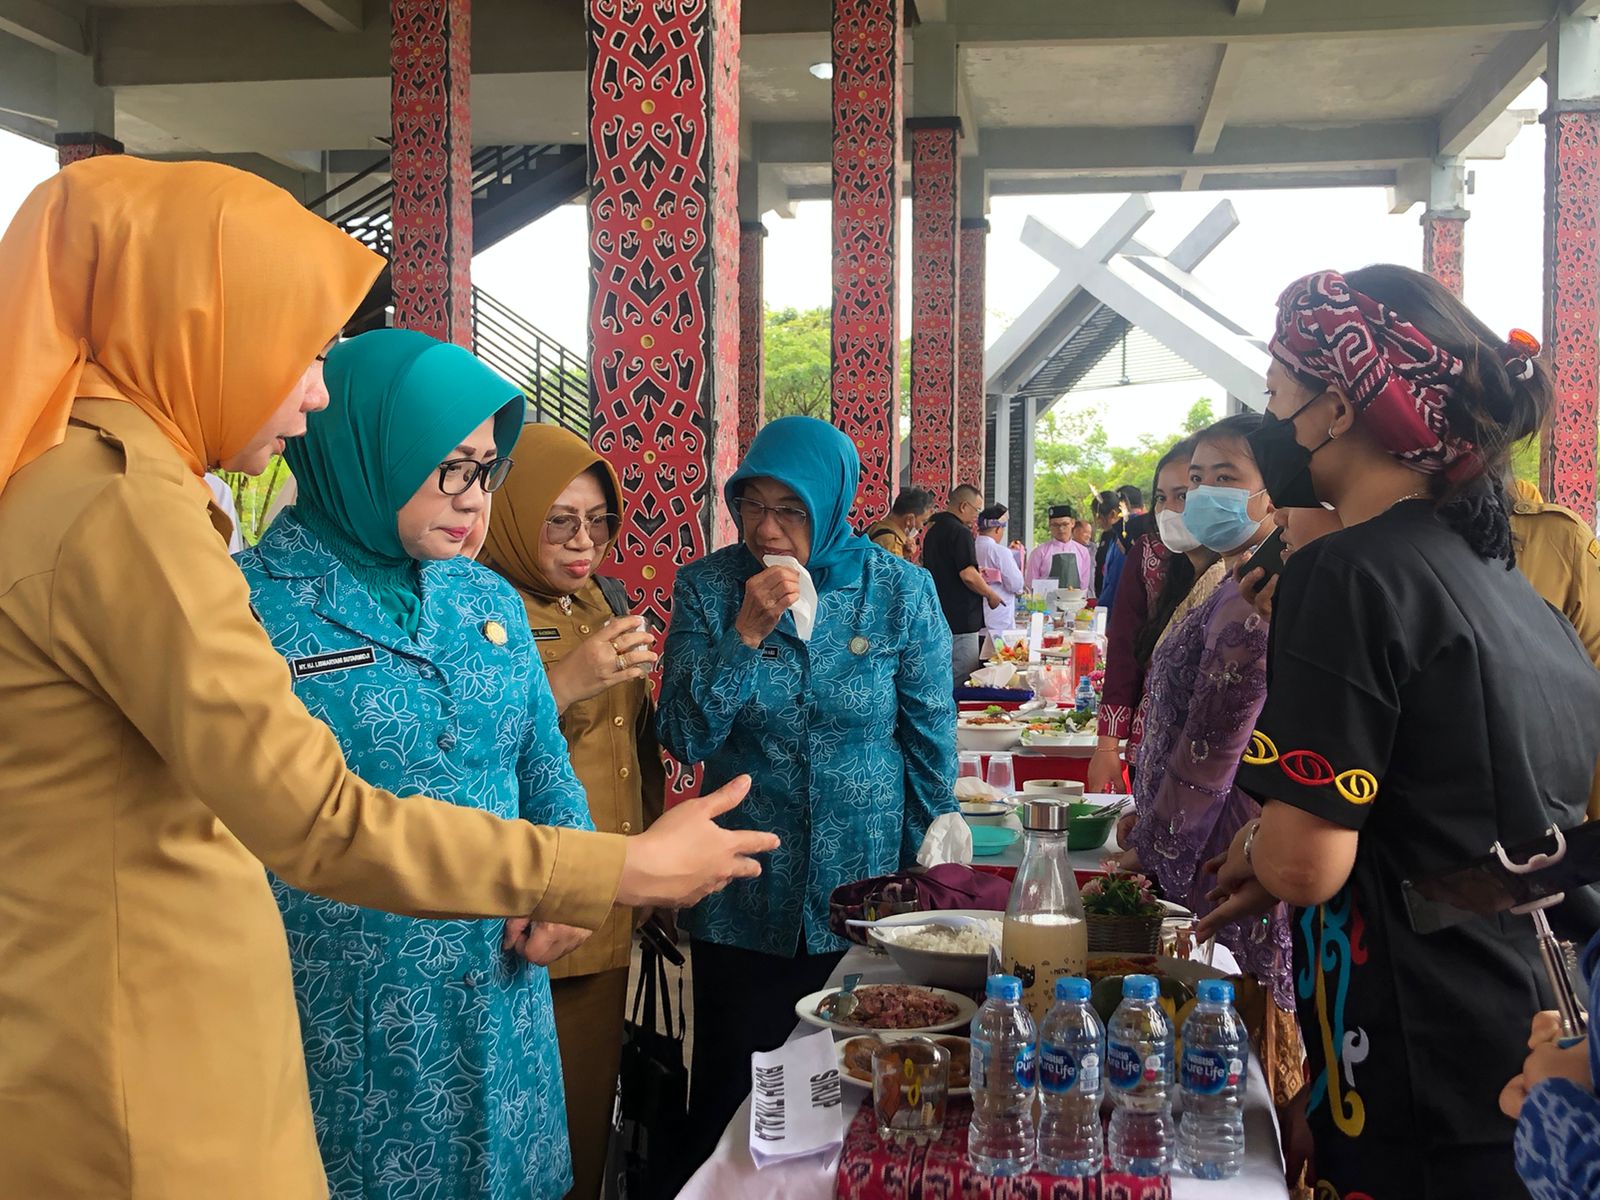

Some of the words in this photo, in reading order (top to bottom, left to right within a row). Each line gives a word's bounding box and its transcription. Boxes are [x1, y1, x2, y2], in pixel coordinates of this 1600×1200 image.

[1055, 1064, 1075, 1080] Life
[1121, 1060, 1140, 1075] Life
[1205, 1066, 1224, 1081] Life
[755, 1064, 784, 1096] BUAH
[810, 1069, 841, 1108] SIRUP
[755, 1098, 785, 1141] TIKALA
